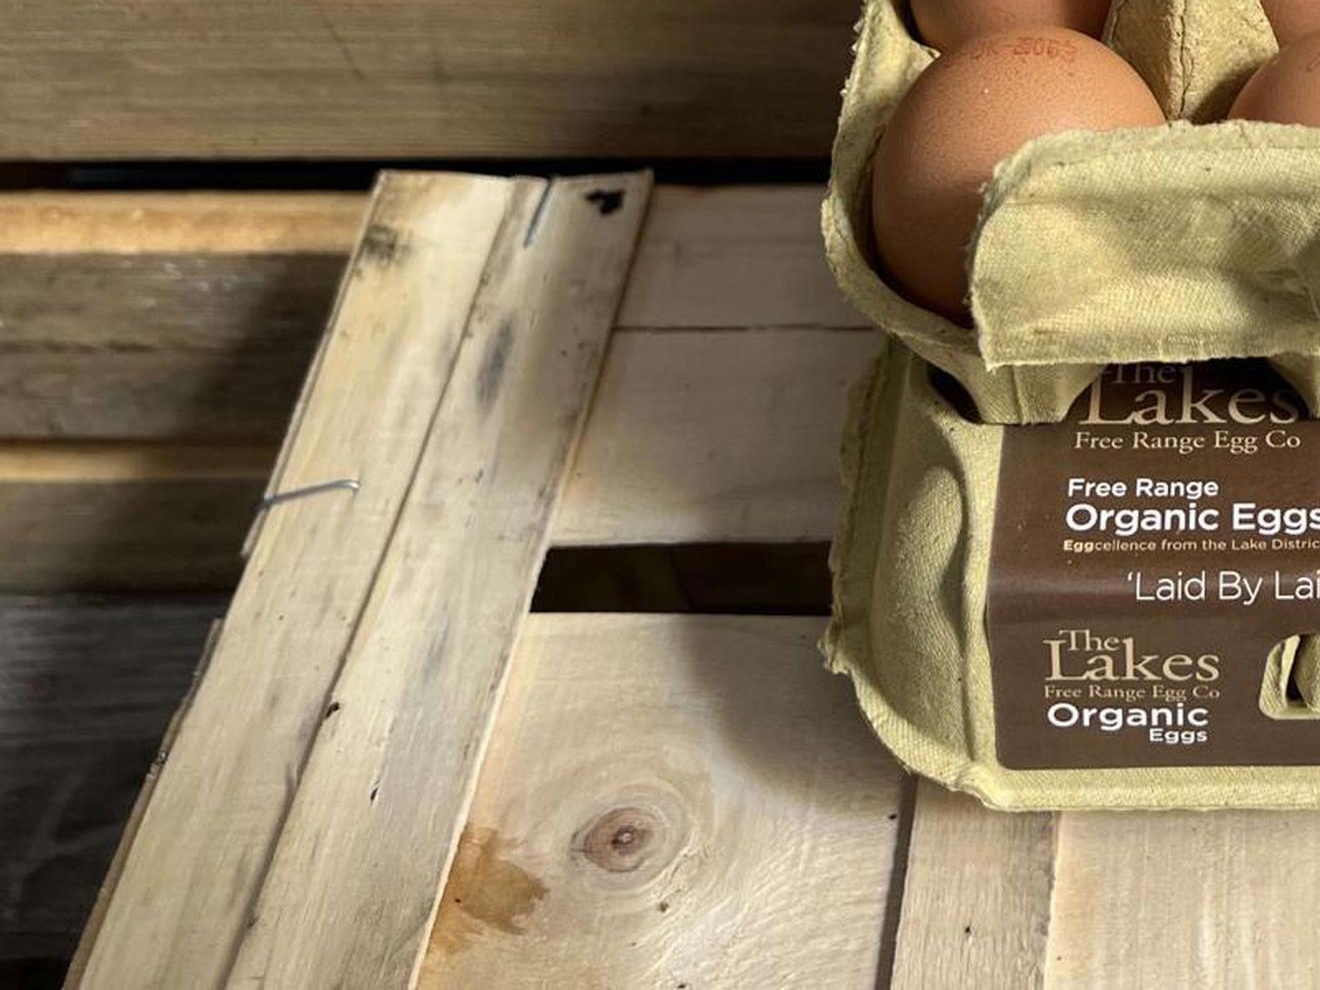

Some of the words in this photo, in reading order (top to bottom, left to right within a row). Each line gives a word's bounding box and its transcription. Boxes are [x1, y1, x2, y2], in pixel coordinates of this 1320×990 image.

[1079, 364, 1300, 425] Lakes
[1075, 431, 1124, 450] Free
[1132, 431, 1205, 454] Range
[1214, 430, 1258, 454] Egg
[1265, 429, 1301, 449] Co
[1068, 478, 1126, 497] Free
[1136, 478, 1219, 499] Range
[1065, 503, 1219, 536] Organic
[1063, 539, 1156, 555] Eggcellence
[1161, 538, 1197, 551] from
[1202, 538, 1226, 551] the
[1231, 538, 1267, 551] Lake
[1218, 571, 1264, 606] By
[1060, 629, 1121, 652] The
[1043, 636, 1220, 682] Lakes
[1044, 685, 1082, 699] Free
[1089, 685, 1146, 702] Range
[1152, 685, 1187, 702] Egg
[1193, 685, 1220, 699] Co
[1047, 702, 1209, 731] Organic
[1149, 728, 1208, 745] Eggs
